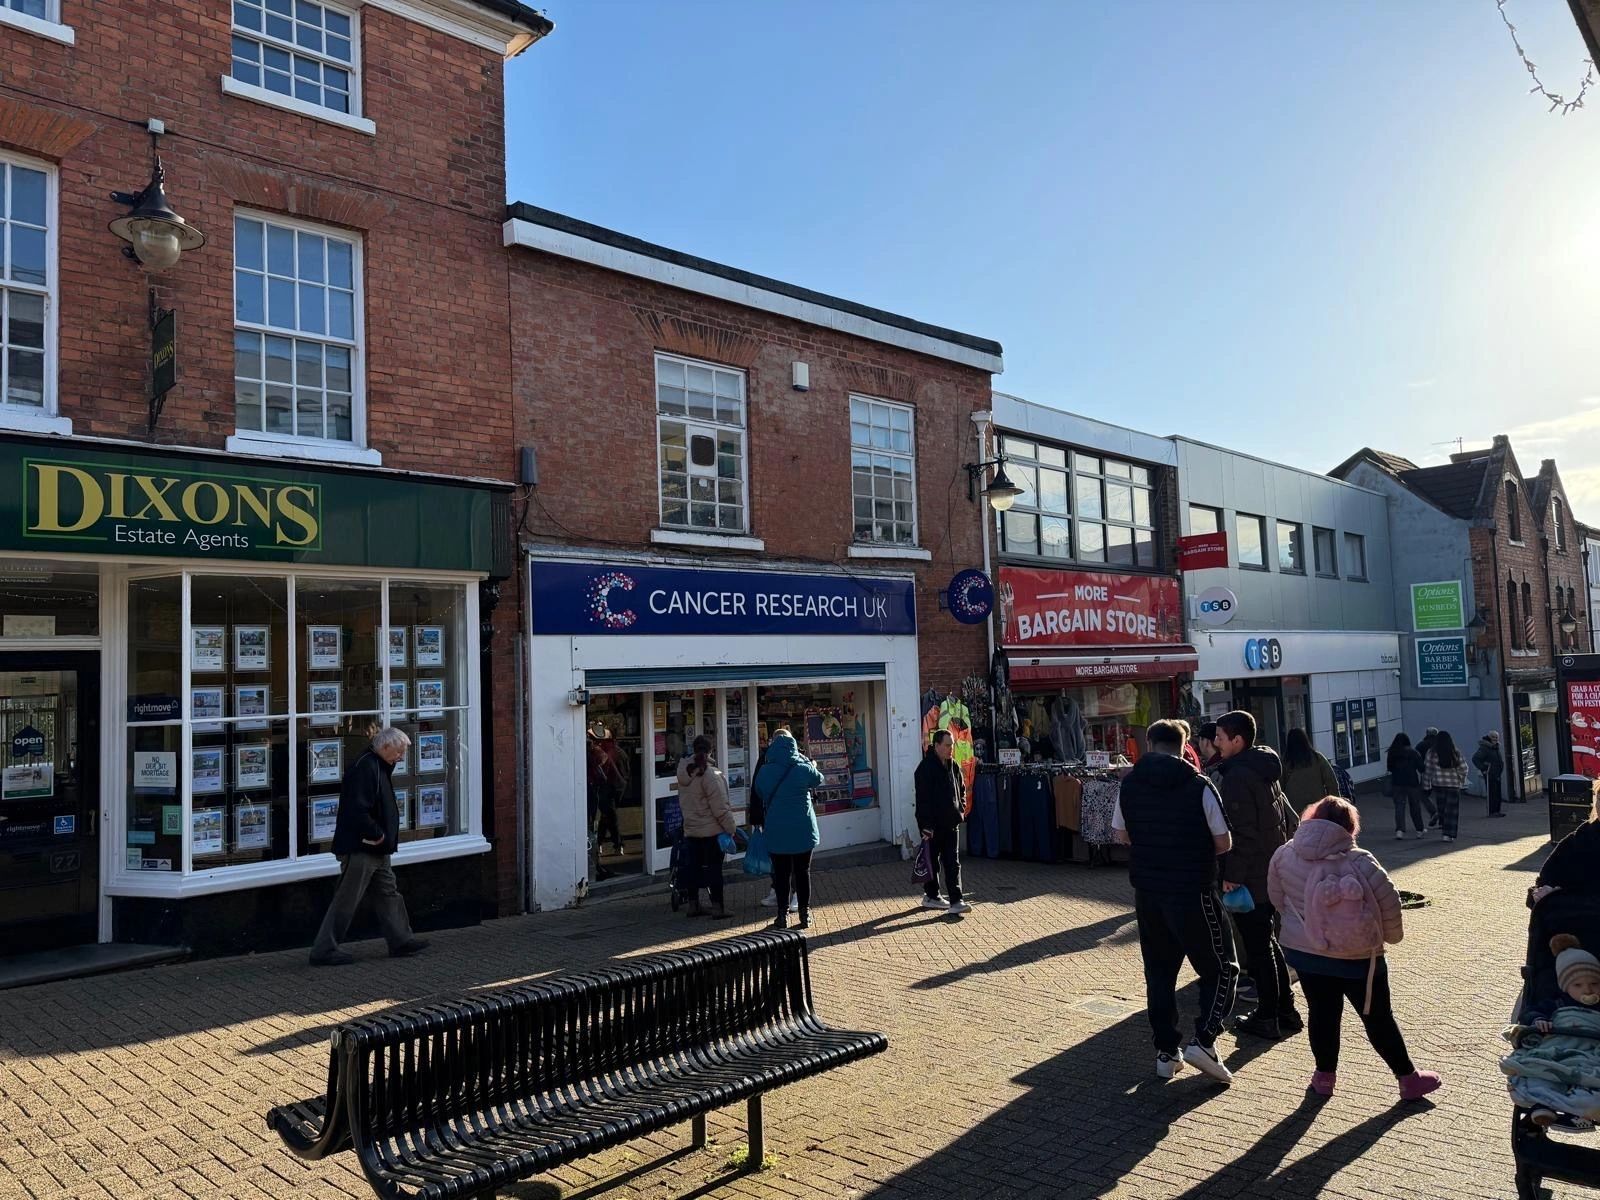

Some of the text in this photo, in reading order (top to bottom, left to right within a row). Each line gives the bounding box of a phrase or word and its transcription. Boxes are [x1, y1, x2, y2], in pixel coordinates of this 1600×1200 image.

[27, 463, 319, 545] DIXONS
[115, 524, 249, 551] Estate Agents
[1183, 547, 1206, 556] BARGAIN
[1074, 585, 1108, 602] MORE
[1418, 586, 1456, 599] Options
[649, 589, 888, 618] CANCER RESEARCH UK
[1202, 601, 1230, 611] TSB
[1418, 603, 1457, 612] SUNBEDS
[1017, 608, 1157, 641] BARGAIN STORE
[1249, 642, 1280, 665] TSB
[1422, 642, 1460, 655] Options
[1425, 655, 1458, 663] BARBER
[1075, 664, 1138, 676] MORE BARGAIN STORE
[1431, 662, 1453, 670] SHOP
[1571, 685, 1588, 693] GRAB
[1588, 685, 1593, 693] A
[1571, 692, 1583, 700] FOR
[1584, 692, 1589, 700] A
[134, 702, 171, 715] rightmove
[1572, 699, 1584, 707] WIN
[14, 736, 43, 747] open
[140, 769, 170, 777] MORTGAGE
[6, 823, 41, 833] rightmove
